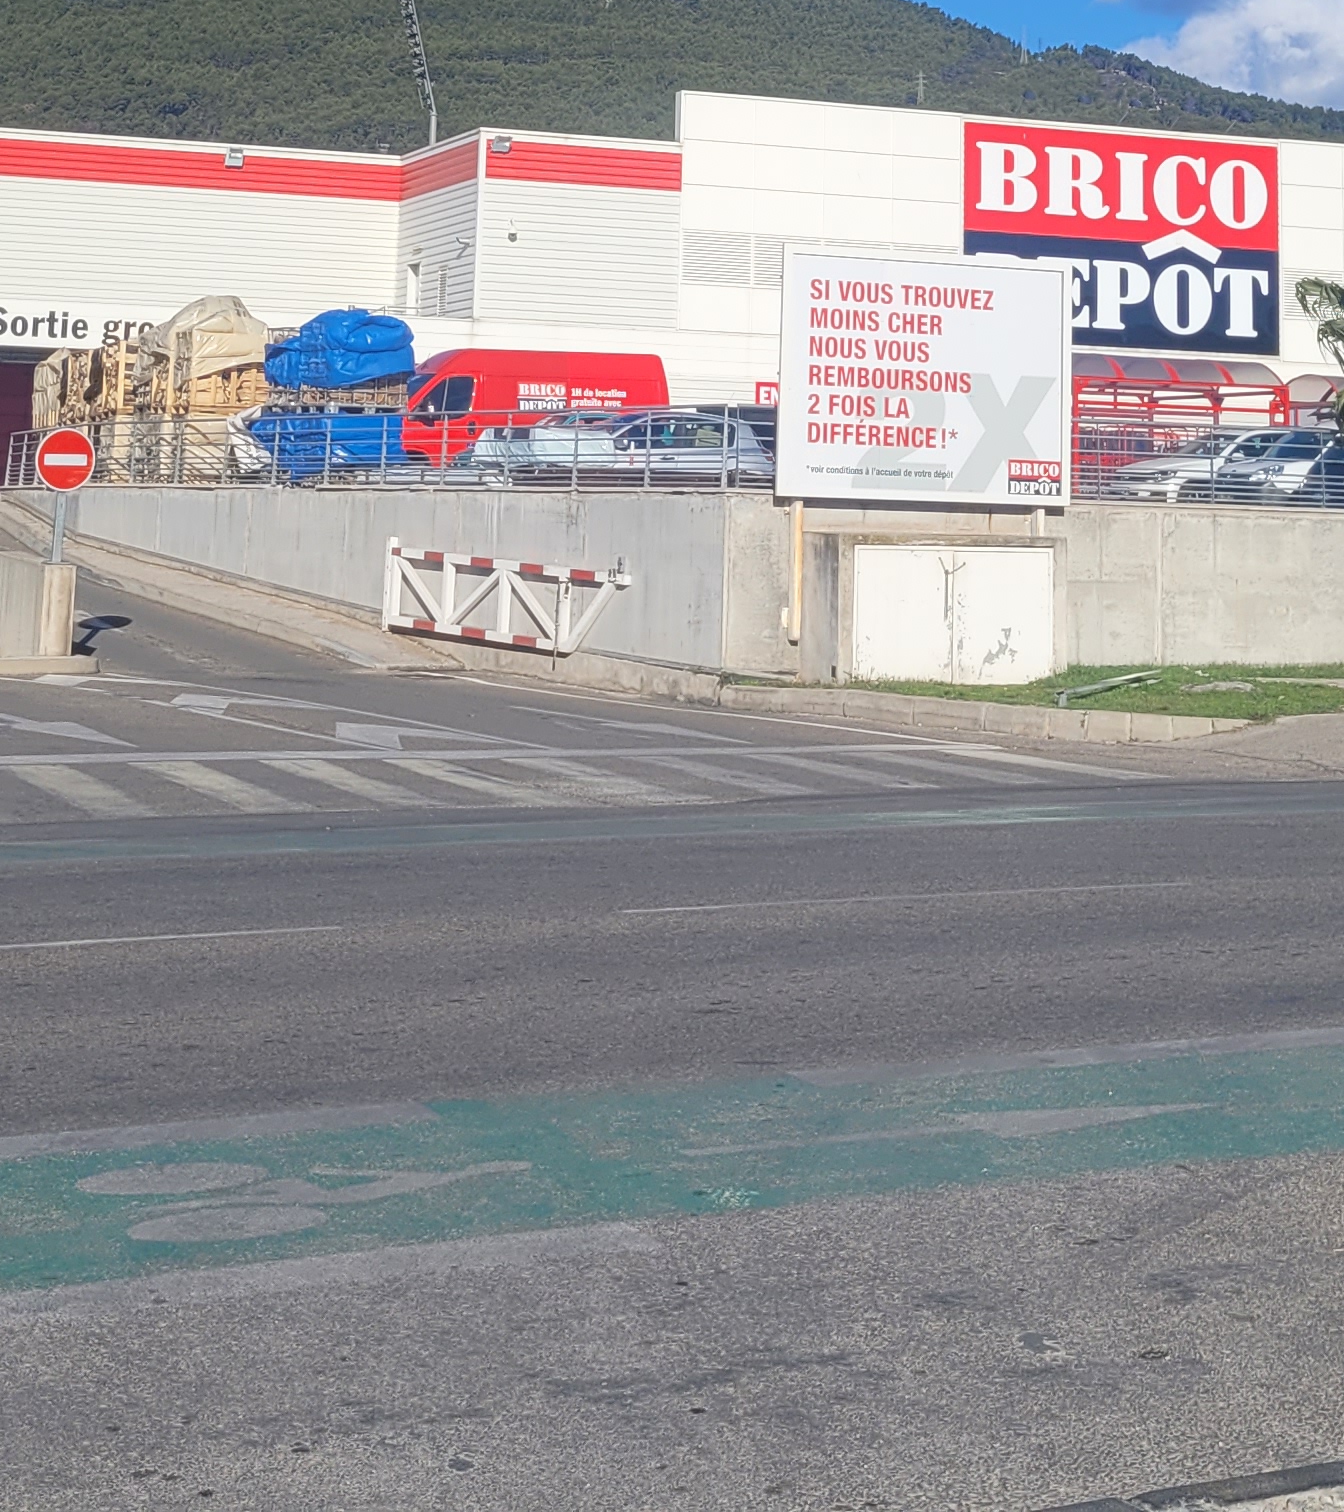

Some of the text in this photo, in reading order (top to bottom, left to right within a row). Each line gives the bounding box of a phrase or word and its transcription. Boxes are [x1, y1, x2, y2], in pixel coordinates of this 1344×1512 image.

[975, 140, 1268, 230] BRICO
[810, 279, 995, 311] SI VOUS TROUVEZ
[810, 308, 943, 336] MOINS CHER
[809, 336, 930, 363] NOUS VOUS
[518, 383, 566, 397] BRICO
[808, 365, 972, 394] REMBOURSONS
[584, 388, 594, 397] de
[595, 388, 627, 398] location
[807, 394, 910, 419] 2 FOIS LA
[826, 465, 863, 475] conditions
[903, 468, 912, 477] de
[914, 470, 932, 478] votre
[1009, 462, 1060, 477] BRICO
[1009, 477, 1060, 496] DEPÔT
